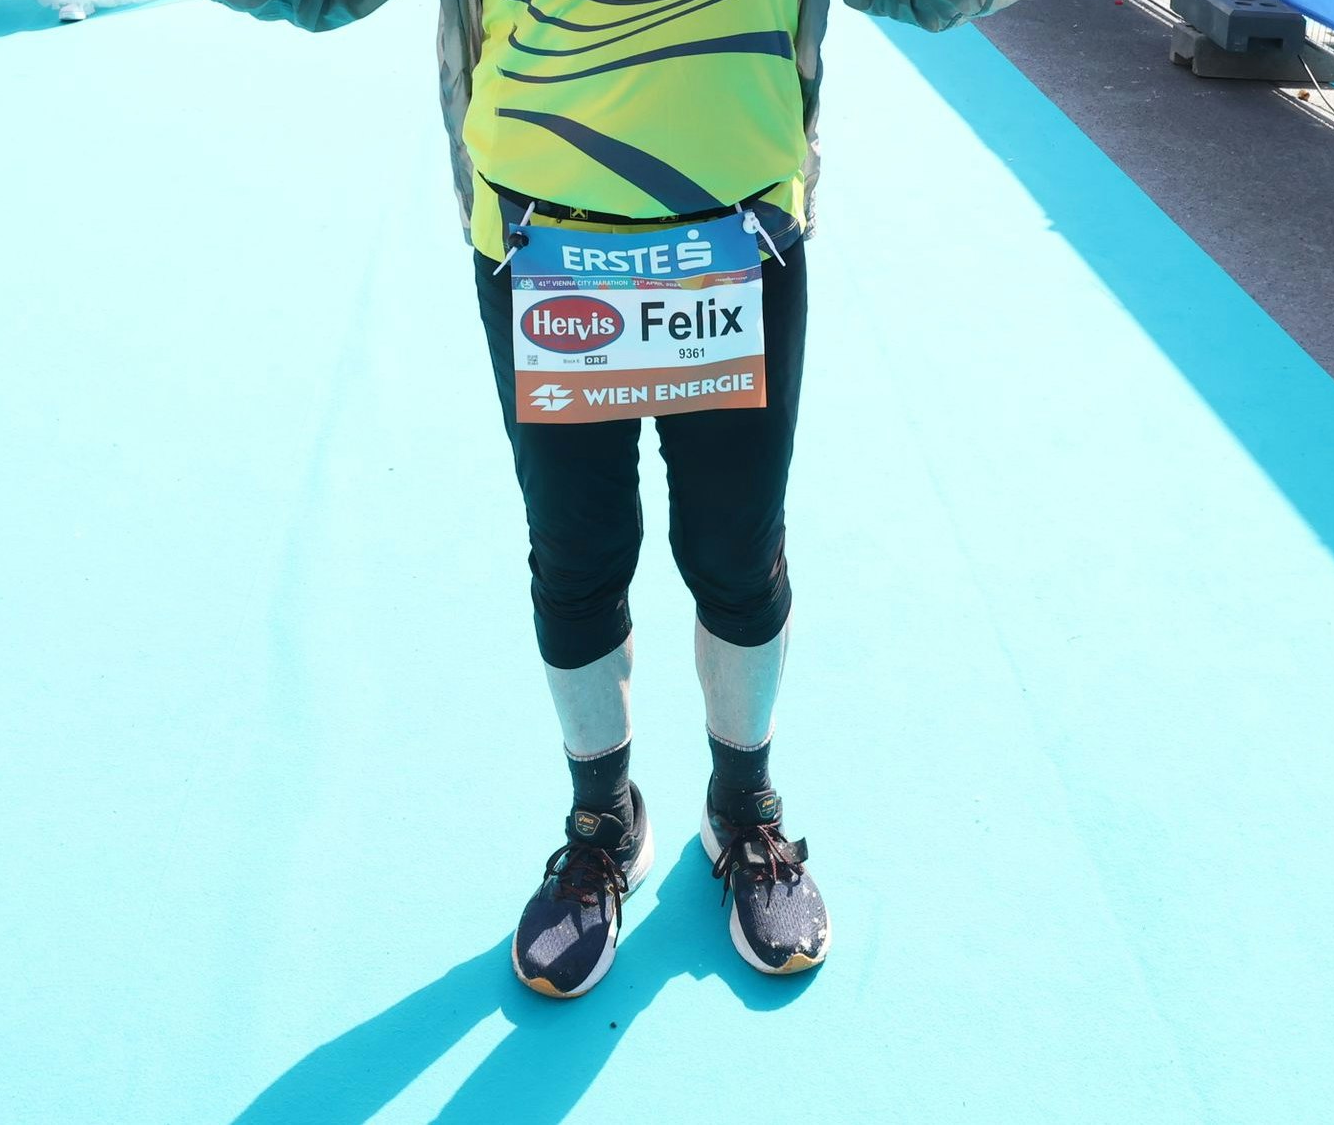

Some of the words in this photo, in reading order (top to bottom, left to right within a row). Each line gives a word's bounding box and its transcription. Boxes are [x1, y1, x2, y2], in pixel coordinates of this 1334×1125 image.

[562, 243, 672, 275] ERSTE
[552, 279, 576, 287] VIENNA
[577, 279, 592, 287] CITY
[593, 279, 628, 287] MARATHON
[532, 308, 616, 341] Hervis
[640, 298, 744, 342] Felix
[586, 356, 607, 364] ORF
[679, 347, 706, 360] 9361
[582, 385, 649, 407] WIEN
[655, 372, 755, 401] ENERGIE
